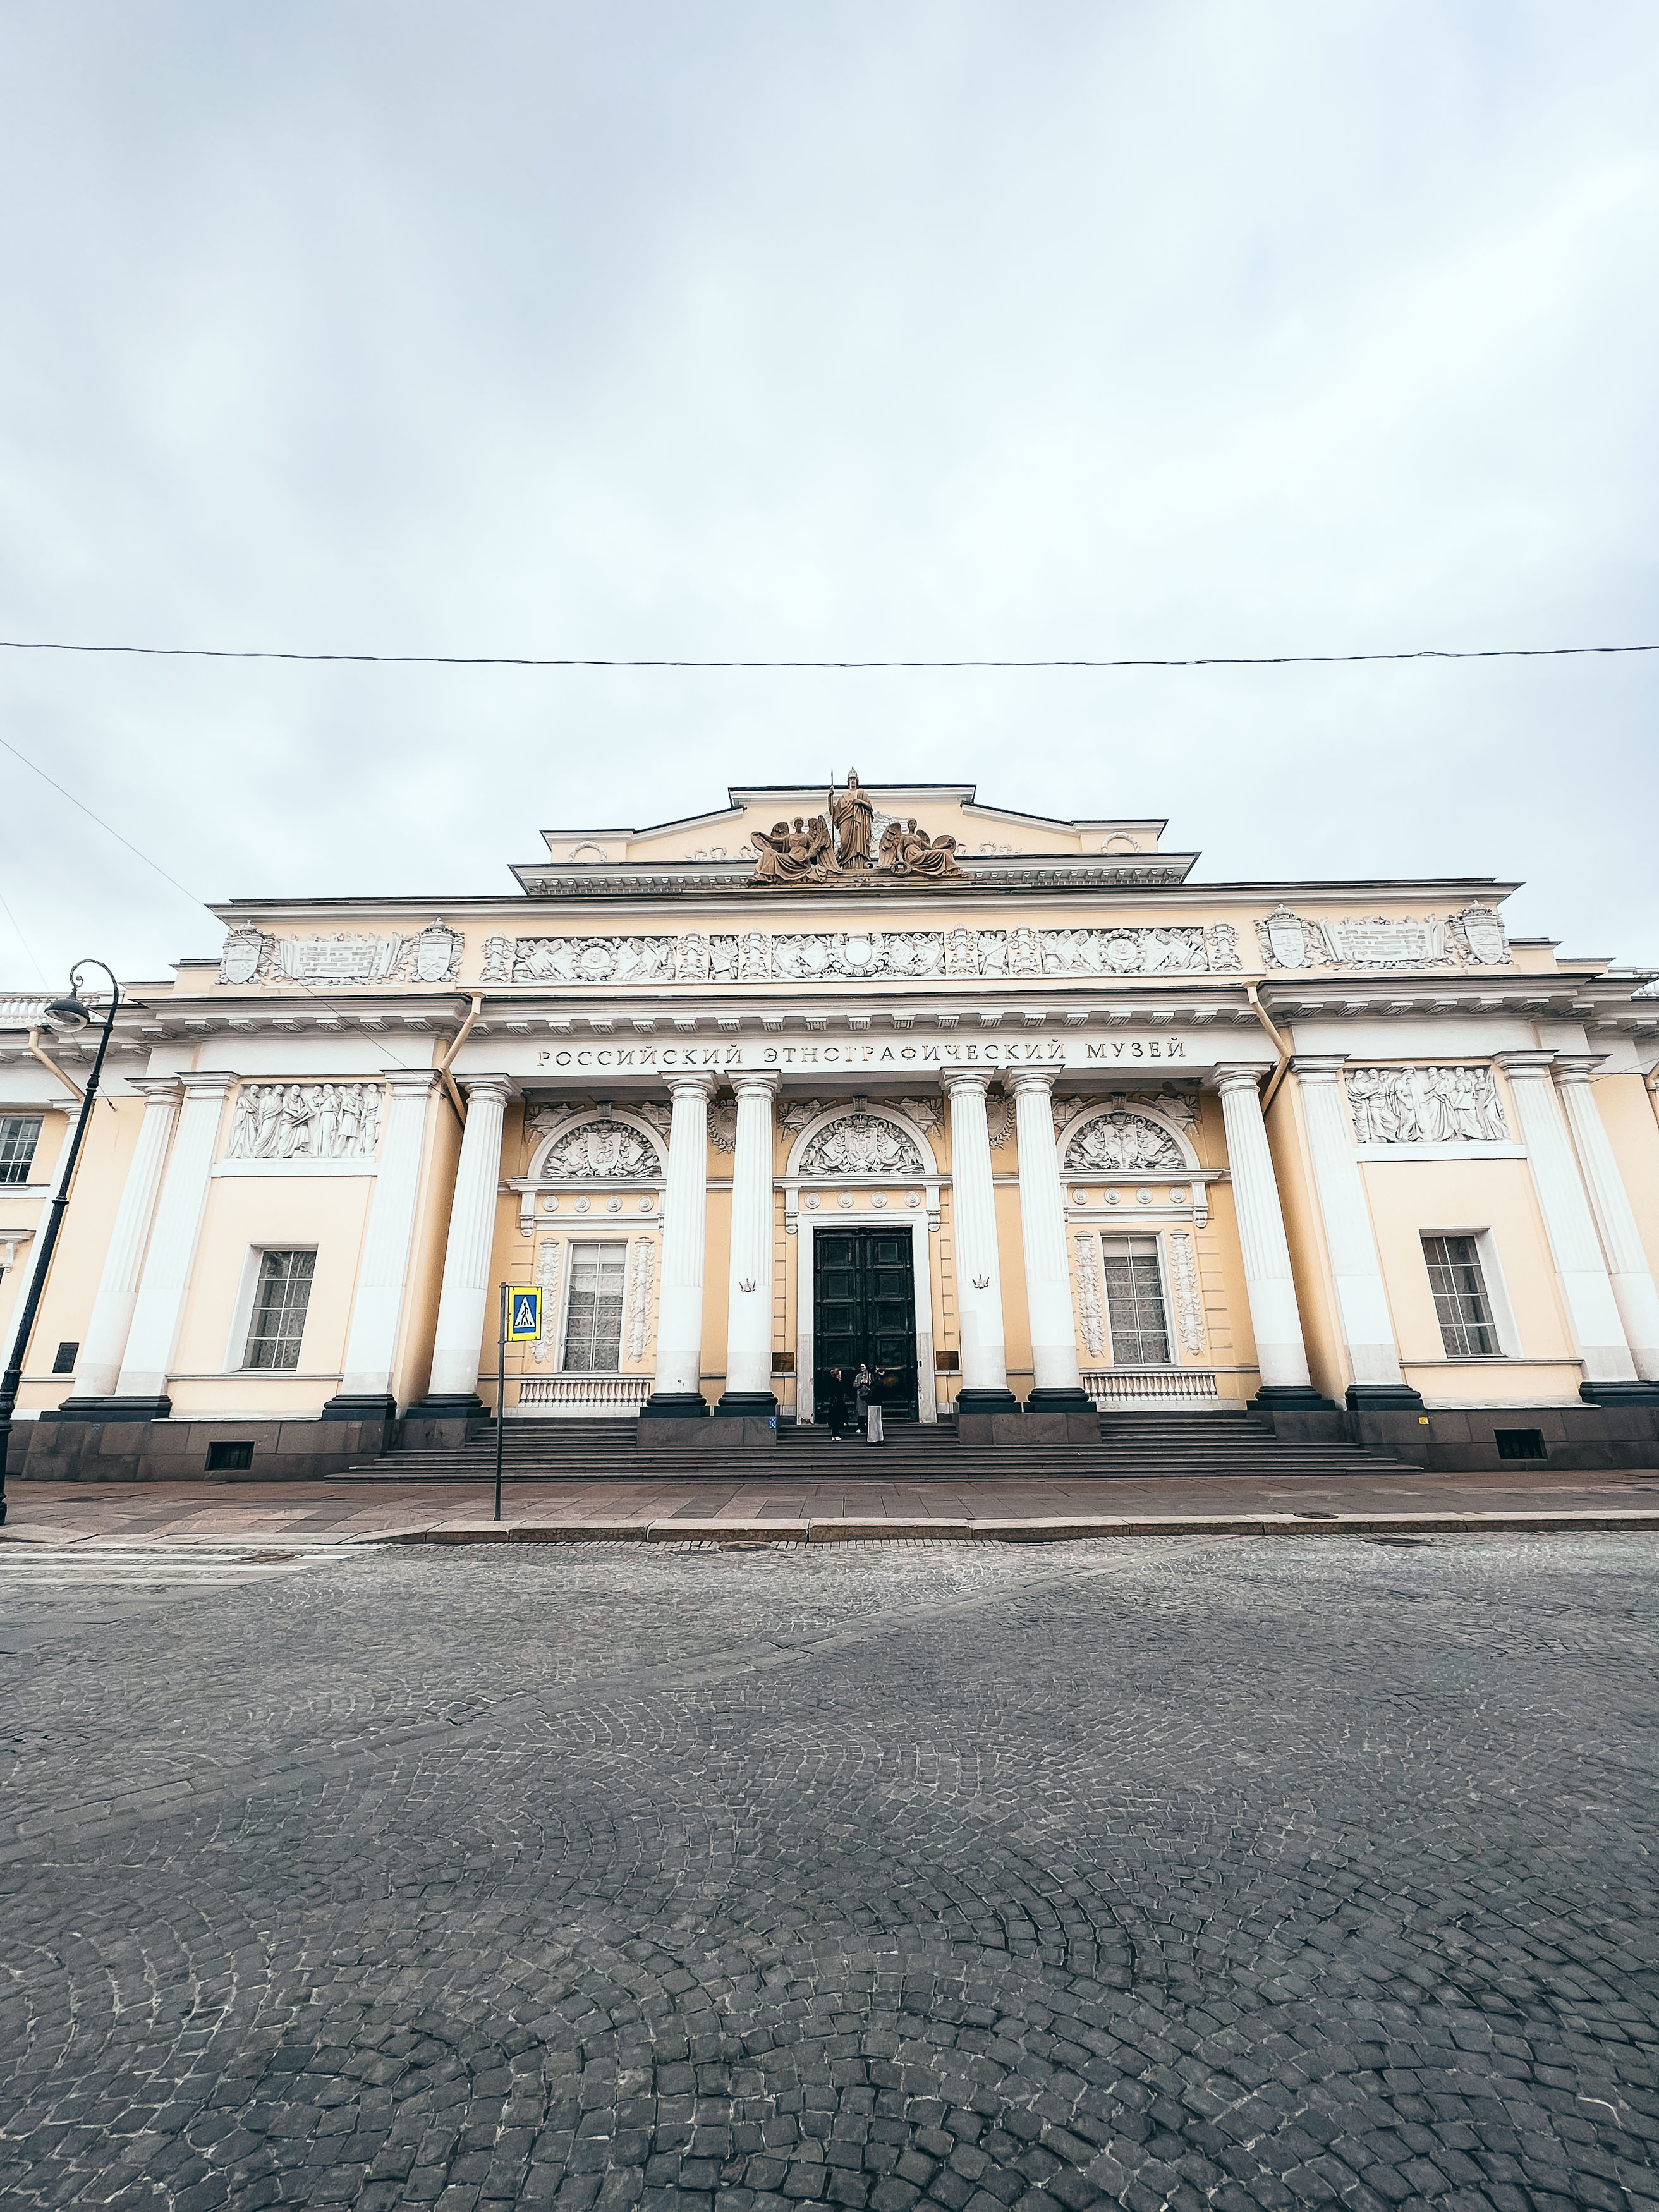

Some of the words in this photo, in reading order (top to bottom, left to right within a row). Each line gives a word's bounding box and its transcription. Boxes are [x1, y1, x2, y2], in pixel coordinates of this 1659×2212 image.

[537, 1043, 743, 1066] РОССИЙСКИЙ
[763, 1039, 1066, 1062] ЭТНОГРАФИЧЕСКИЙ
[1085, 1037, 1186, 1058] МУЗЕЙ
